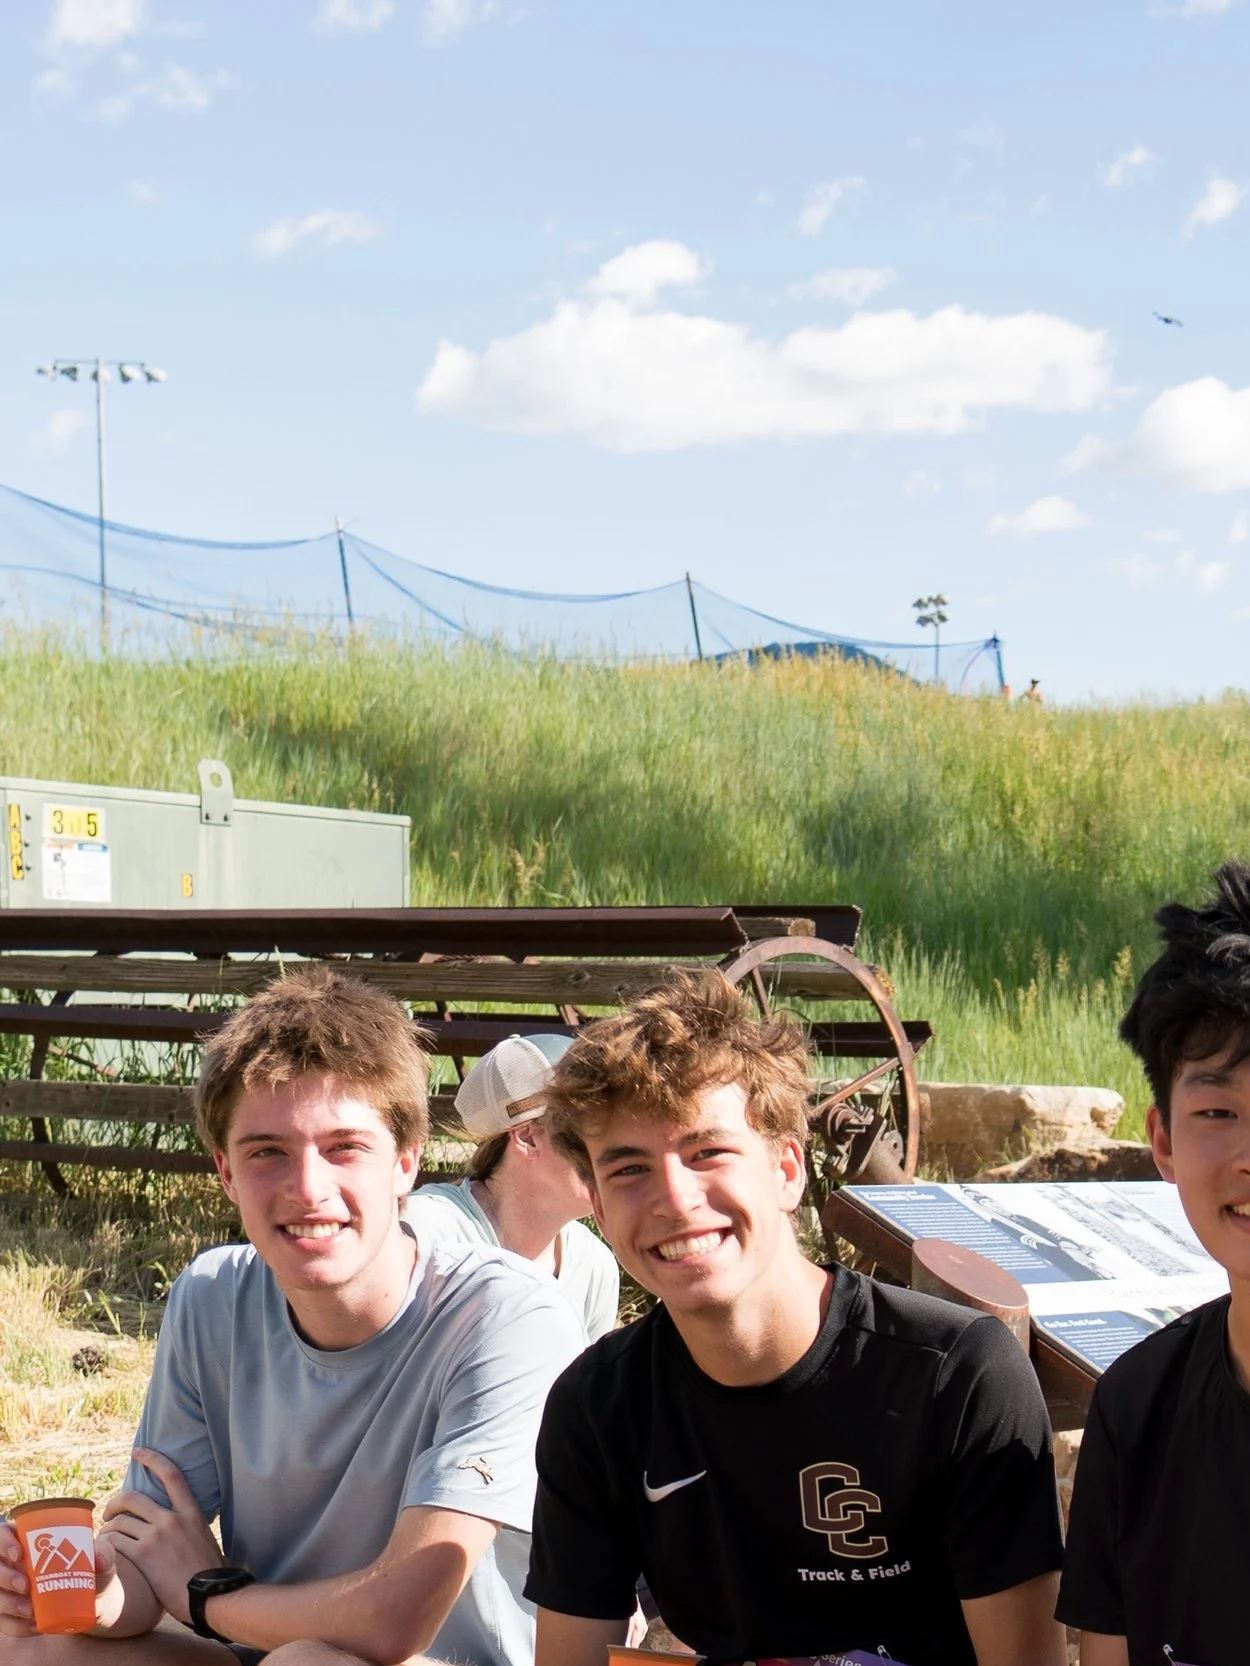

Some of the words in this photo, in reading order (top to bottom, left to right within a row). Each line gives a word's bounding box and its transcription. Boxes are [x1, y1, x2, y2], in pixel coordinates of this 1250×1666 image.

[797, 1567, 846, 1582] Track
[850, 1569, 864, 1581] &
[868, 1560, 912, 1580] Field
